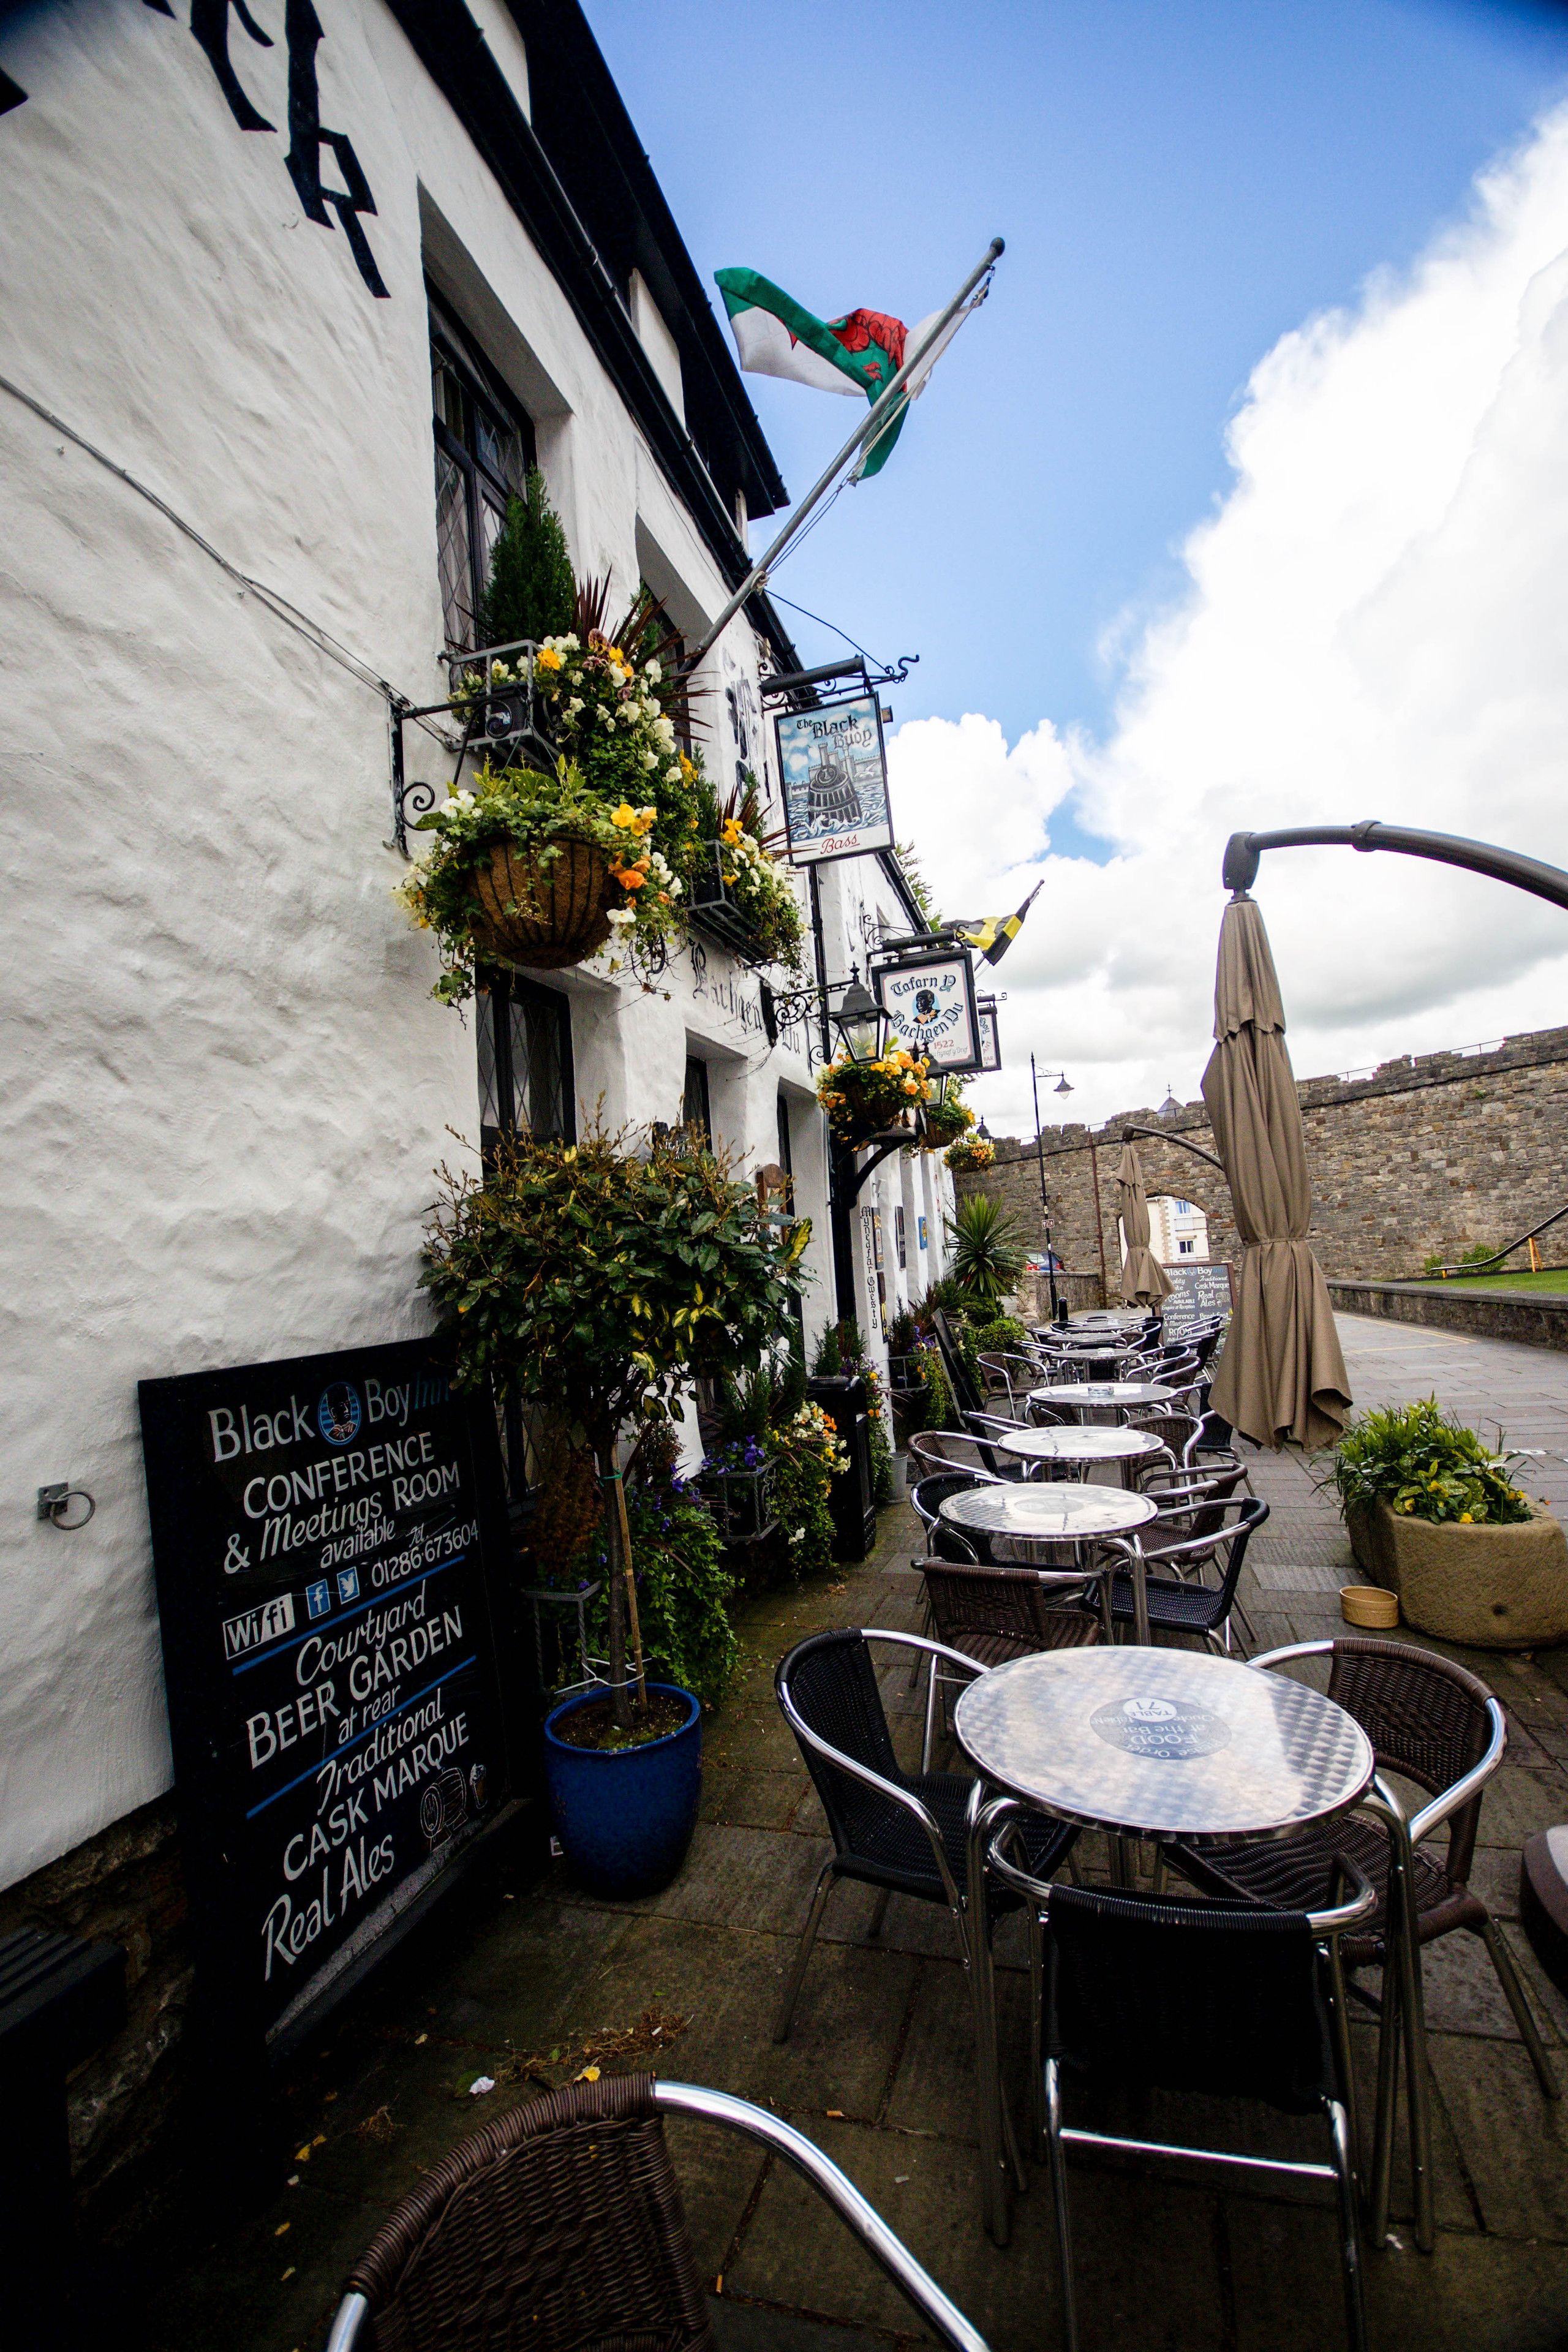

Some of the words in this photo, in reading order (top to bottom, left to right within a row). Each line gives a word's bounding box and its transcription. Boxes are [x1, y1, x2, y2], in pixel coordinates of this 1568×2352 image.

[796, 718, 812, 729] The
[811, 714, 859, 740] Black
[820, 834, 860, 854] Bass
[890, 975, 938, 997] Tafarn
[888, 1009, 949, 1043] Bachgen
[940, 1001, 964, 1027] Du
[933, 1039, 955, 1050] 1522
[1163, 1267, 1188, 1276] Black
[1197, 1266, 1213, 1275] Boy
[1197, 1289, 1215, 1300] Real
[1208, 1281, 1230, 1291] Marque
[866, 1276, 878, 1329] Gwesty
[1200, 1299, 1216, 1308] Ales
[207, 1394, 316, 1463] Black
[363, 1378, 410, 1427] Boy
[243, 1431, 435, 1519] CONFERENCE
[223, 1532, 252, 1574] &
[260, 1491, 383, 1562] Meetings
[391, 1461, 461, 1511] ROOM
[320, 1519, 396, 1569] available
[296, 1579, 426, 1686] Courtyard
[246, 1680, 341, 1770] BEER
[349, 1604, 463, 1701] GARDEN
[337, 1706, 358, 1744] at
[362, 1684, 401, 1728] rear
[1135, 1701, 1160, 1710] 71
[1120, 1726, 1151, 1735] Bar
[1130, 1733, 1199, 1745] FOOD
[1154, 1725, 1183, 1734] the
[1190, 1724, 1205, 1733] at
[316, 1687, 445, 1816] Traditional
[1122, 1744, 1170, 1758] Order
[283, 1787, 369, 1881] CASK
[372, 1712, 470, 1813] MARQUE
[261, 1866, 335, 1981] Real
[340, 1834, 396, 1917] Ales
